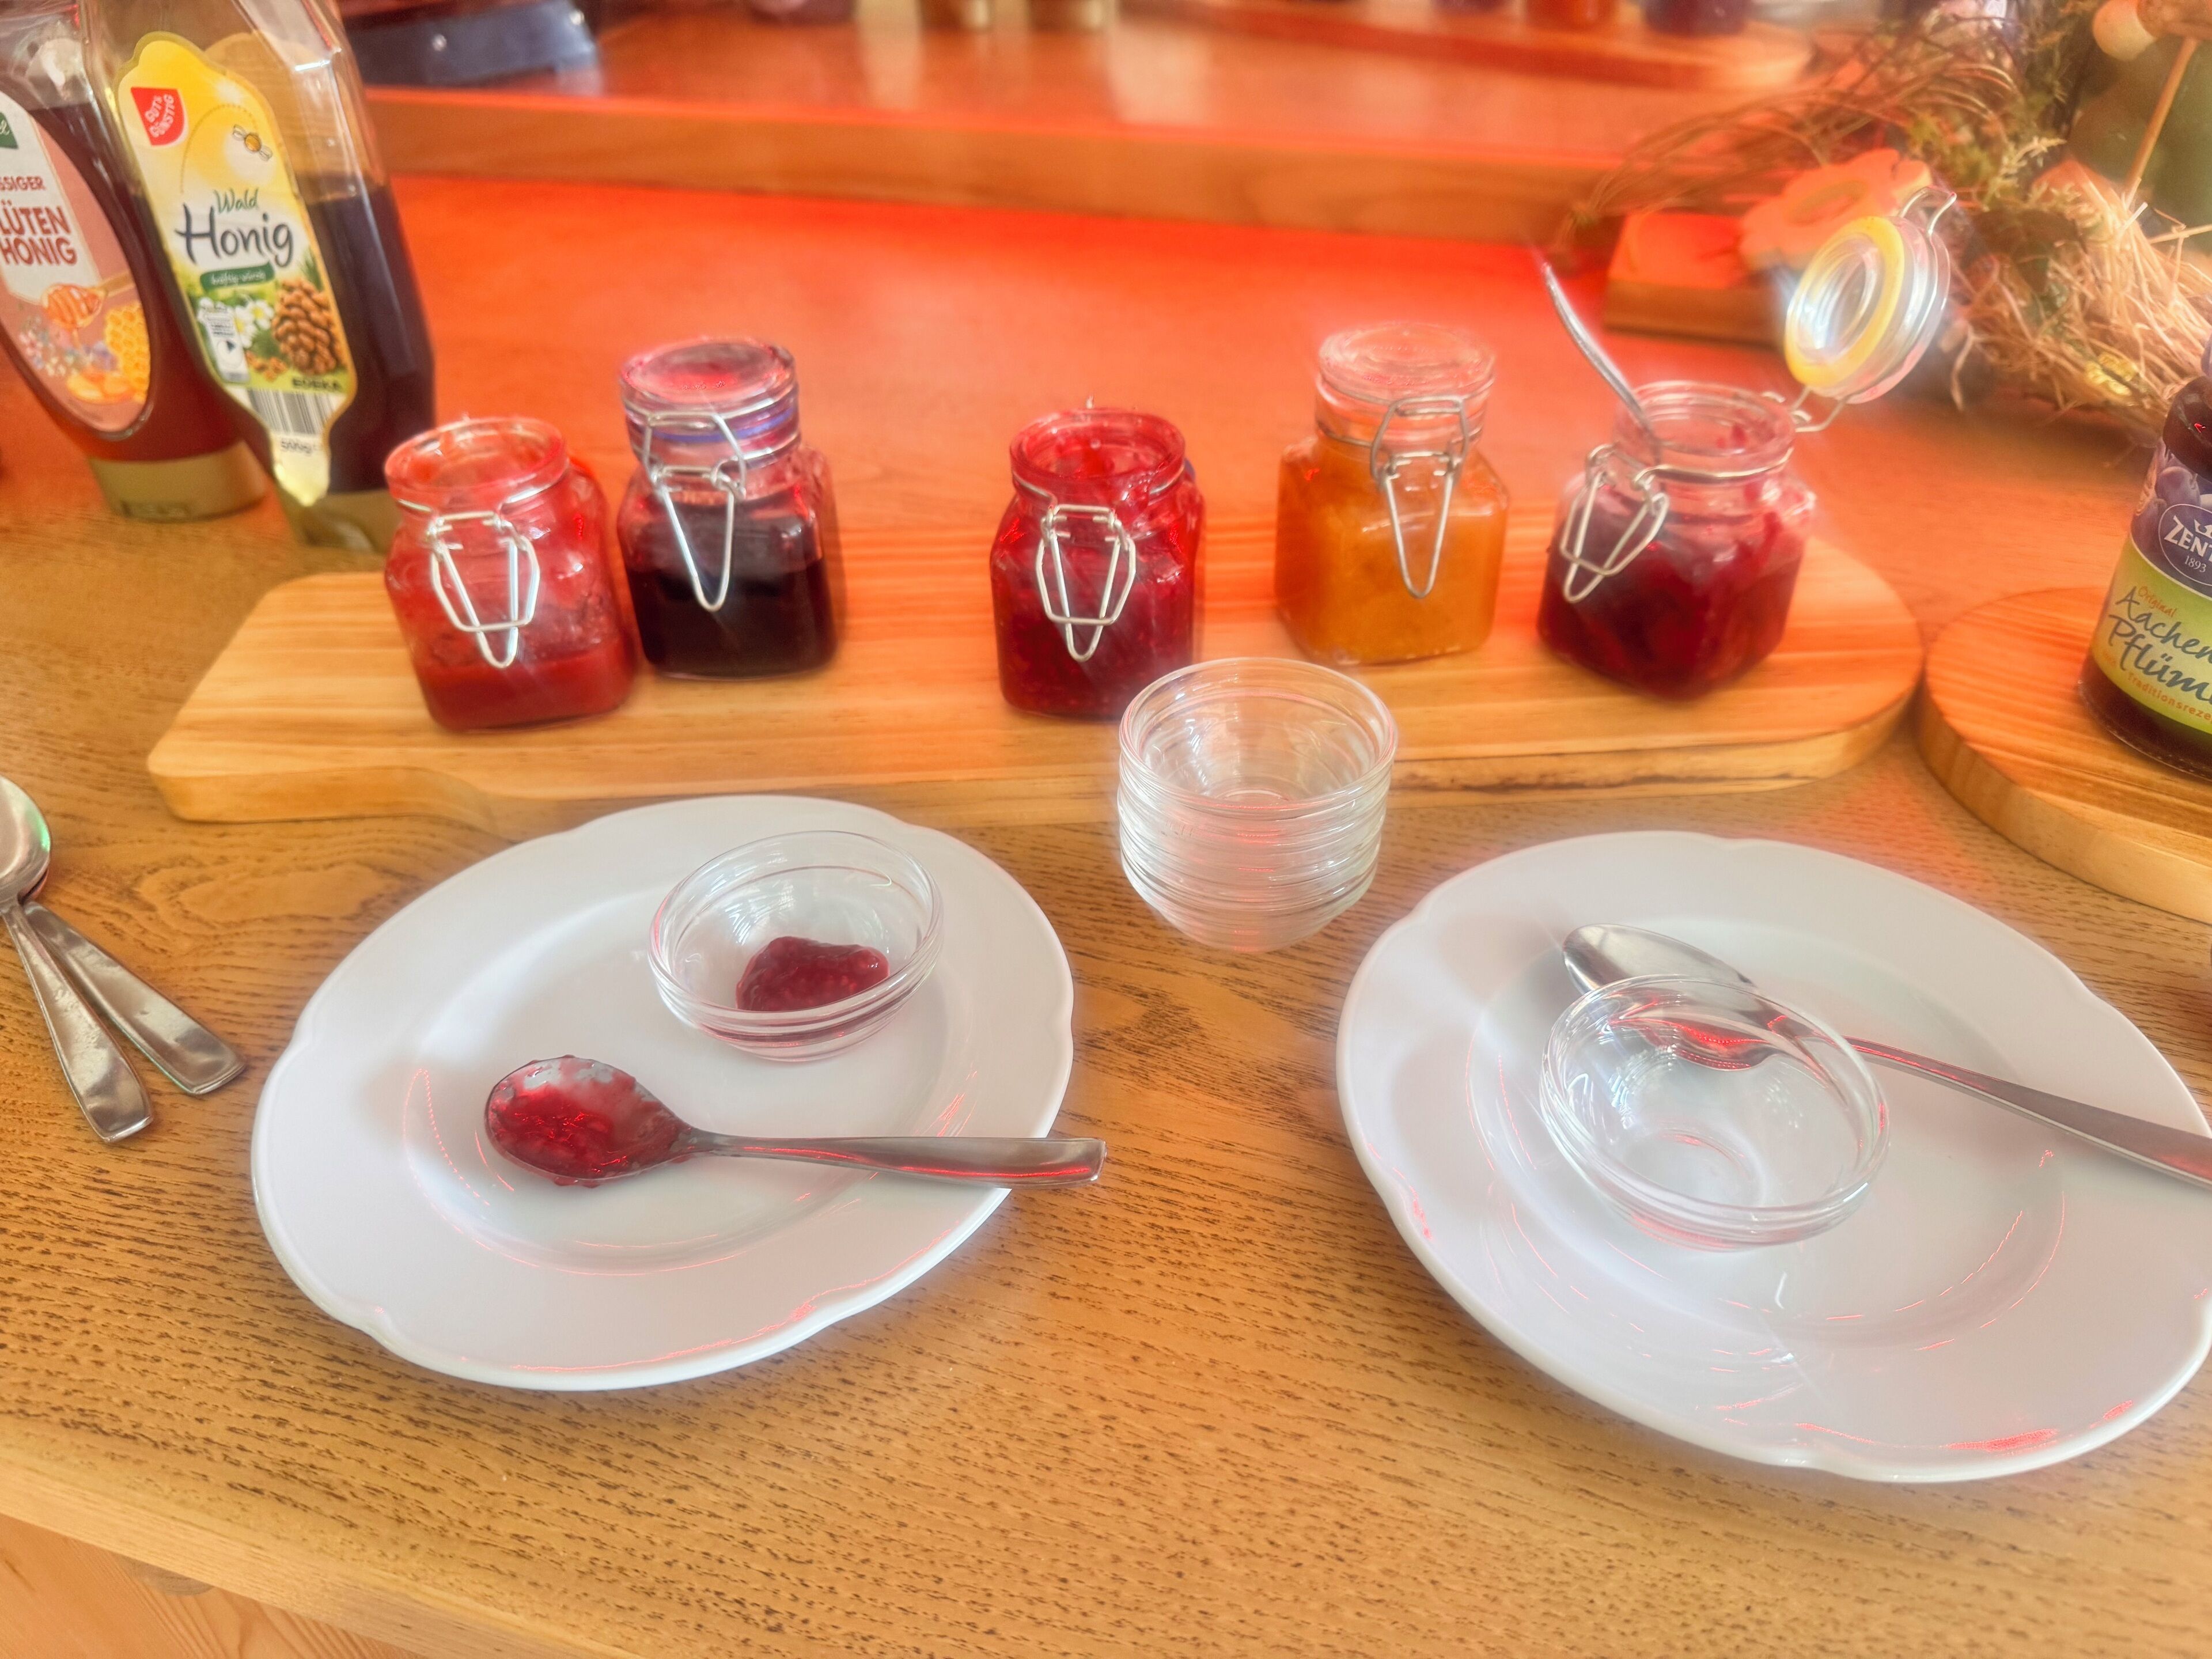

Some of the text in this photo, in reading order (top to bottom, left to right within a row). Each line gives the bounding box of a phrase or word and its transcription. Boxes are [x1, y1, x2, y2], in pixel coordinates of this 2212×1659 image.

[213, 189, 259, 214] Wald
[175, 202, 294, 267] Honig
[0, 237, 77, 265] HONIG
[2184, 555, 2207, 573] 1893
[2138, 586, 2177, 618] Original
[2108, 615, 2212, 705] Pflüm
[2128, 672, 2212, 724] Traditionsreze
